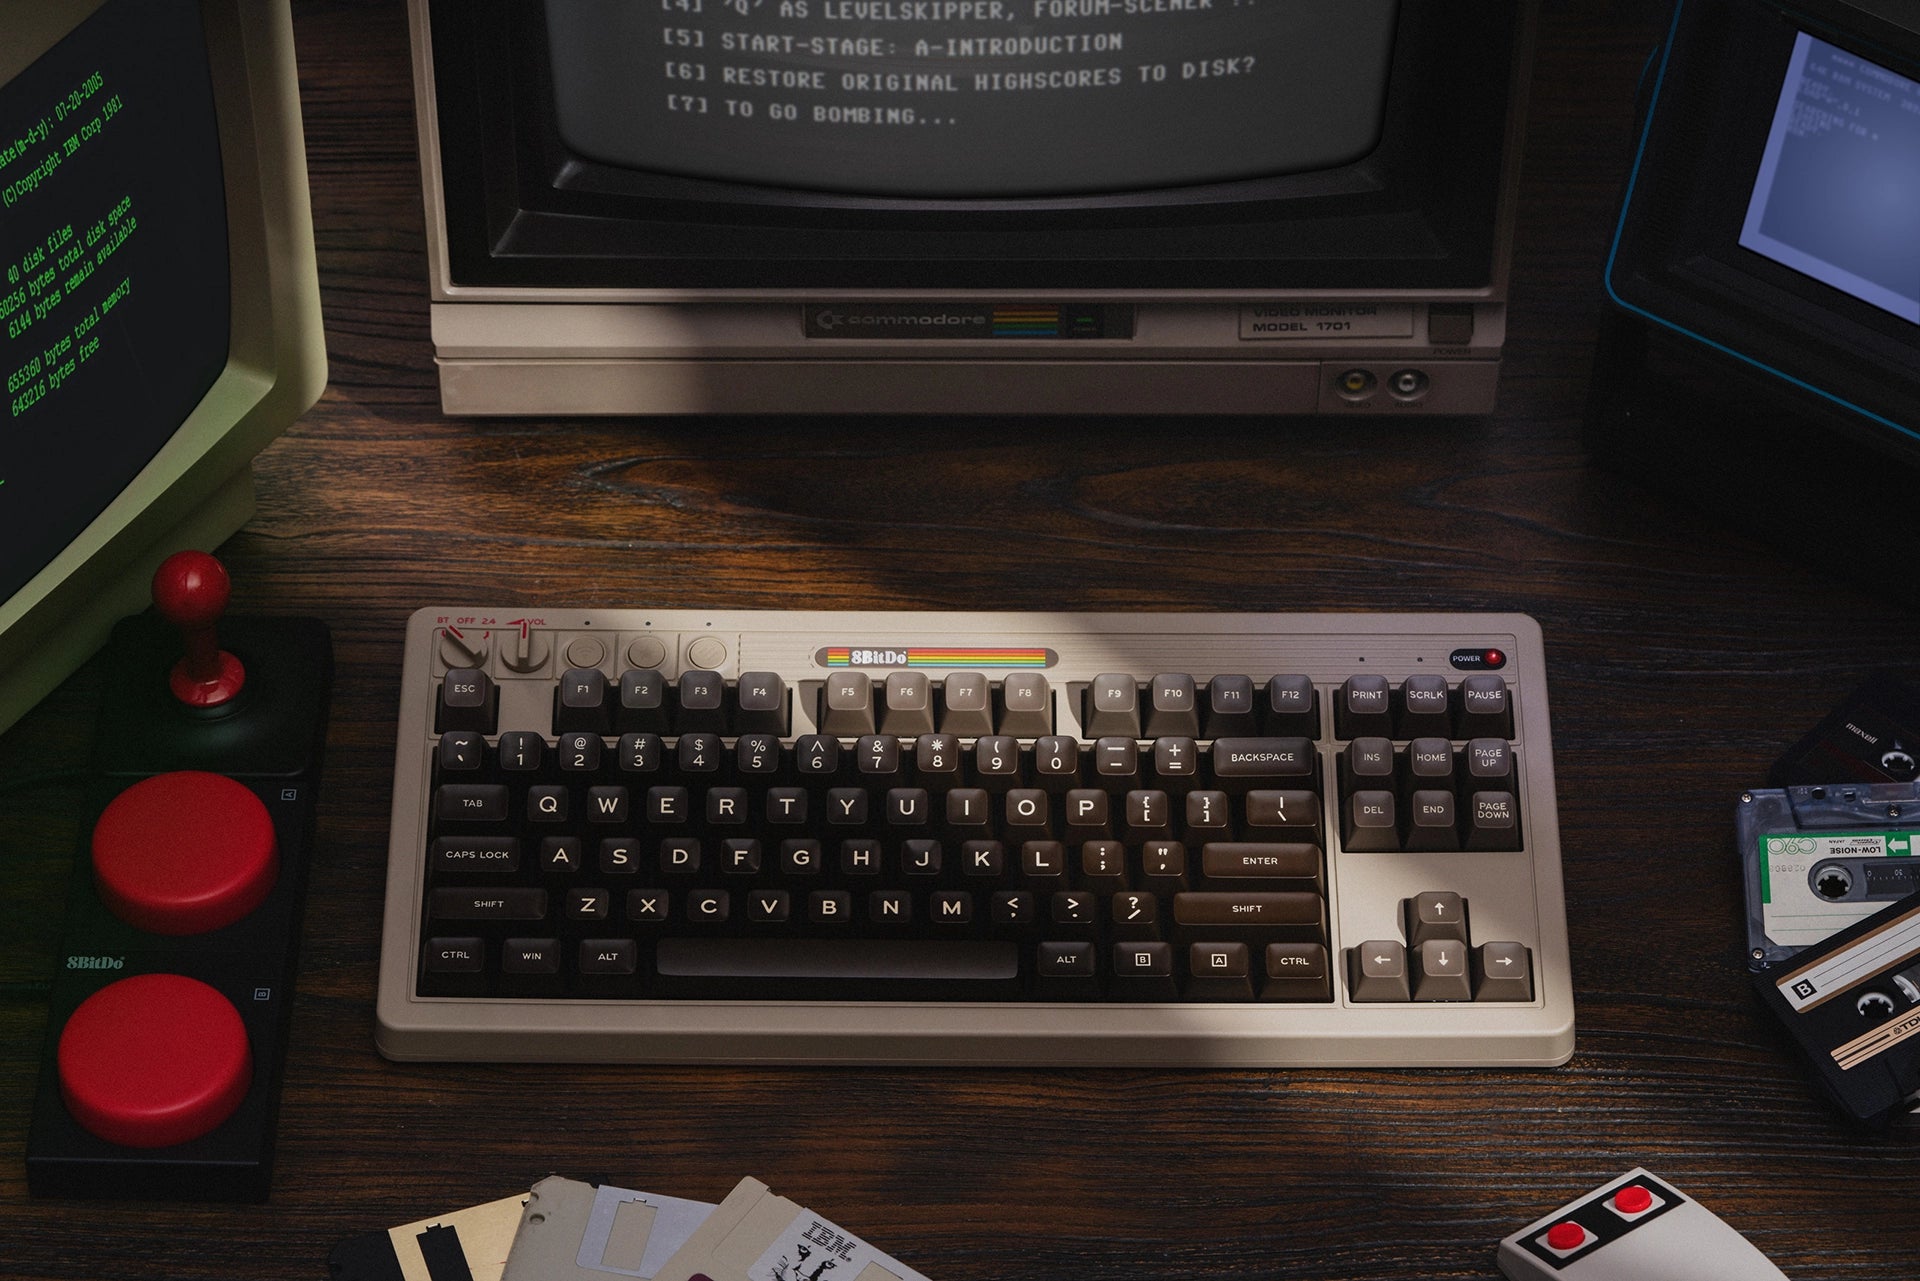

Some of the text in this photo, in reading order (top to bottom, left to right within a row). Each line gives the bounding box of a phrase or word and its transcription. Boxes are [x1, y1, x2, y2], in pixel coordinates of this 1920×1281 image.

[779, 1, 809, 18] AS
[824, 1, 1015, 20] LEVELSKIPPER,
[663, 28, 1123, 56] [5] START-STAGE: A-INTRODUCTION
[665, 56, 1255, 92] [6] RESTORE ORIGINAL HIGHSCORES TO DISK?
[55, 71, 104, 122] 07-20-2005
[667, 94, 955, 124] [7] TO GO BOMBING...
[63, 133, 81, 157] IBM
[81, 117, 101, 141] Corp
[102, 94, 123, 122] 1981
[27, 266, 56, 297] bytes
[58, 239, 84, 272] total
[86, 220, 107, 248] disk
[107, 195, 131, 227] space
[7, 224, 73, 284] 40 disk files
[8, 216, 137, 339] 6144 bytes remain available
[1253, 303, 1377, 318] VIDEO MONITOR
[850, 313, 986, 325] commodore
[1253, 321, 1352, 332] MODEL 1701
[7, 277, 131, 393] 655360 bytes total memory
[11, 336, 100, 417] 643216 bytes free
[527, 618, 546, 626] VOL
[851, 650, 906, 664] 8BitDo
[635, 686, 647, 694] F2
[753, 688, 766, 696] F4
[1165, 689, 1182, 697] F10
[1353, 691, 1382, 699] PRINT
[1410, 691, 1443, 699] SCRLK
[1469, 691, 1501, 699] PAUSE
[1845, 723, 1878, 744] maxell
[520, 738, 522, 749] !
[575, 738, 586, 749] @
[635, 739, 645, 749] #
[695, 739, 703, 750] $
[751, 740, 766, 752] %
[873, 741, 883, 752] &
[517, 754, 522, 765] 1
[1232, 753, 1293, 762] BACKSPACE
[1417, 753, 1446, 761] HOME
[1476, 749, 1502, 757] PAGE
[575, 755, 584, 766] 2
[634, 755, 643, 766] 3
[693, 755, 704, 766] 4
[752, 756, 761, 767] 5
[812, 757, 822, 768] 6
[872, 757, 881, 768] 7
[933, 755, 942, 767] 8
[992, 757, 1002, 769] 9
[1051, 758, 1061, 769] 0
[540, 796, 556, 812] Q
[598, 798, 618, 813] W
[661, 798, 674, 813] E
[720, 799, 734, 814] R
[780, 799, 795, 814] T
[840, 799, 854, 814] Y
[900, 800, 914, 815] U
[965, 800, 968, 815] I
[1018, 800, 1035, 815] O
[1080, 800, 1094, 816] P
[1767, 837, 1817, 855] C90
[1830, 846, 1881, 854] LOW-NOISE
[553, 848, 568, 862] A
[613, 849, 627, 863] S
[673, 849, 688, 863] D
[735, 851, 747, 865] F
[793, 850, 809, 864] G
[854, 851, 868, 865] H
[916, 852, 928, 866] J
[976, 852, 989, 866] K
[1036, 852, 1049, 866] L
[581, 898, 595, 911] Z
[641, 899, 655, 912] X
[701, 900, 716, 913] C
[762, 900, 777, 913] V
[823, 901, 836, 914] B
[884, 901, 898, 914] N
[943, 901, 960, 914] M
[1129, 897, 1138, 908] ?
[66, 956, 124, 970] 8BitDo
[1797, 983, 1812, 997] B
[802, 1221, 856, 1260] IBM
